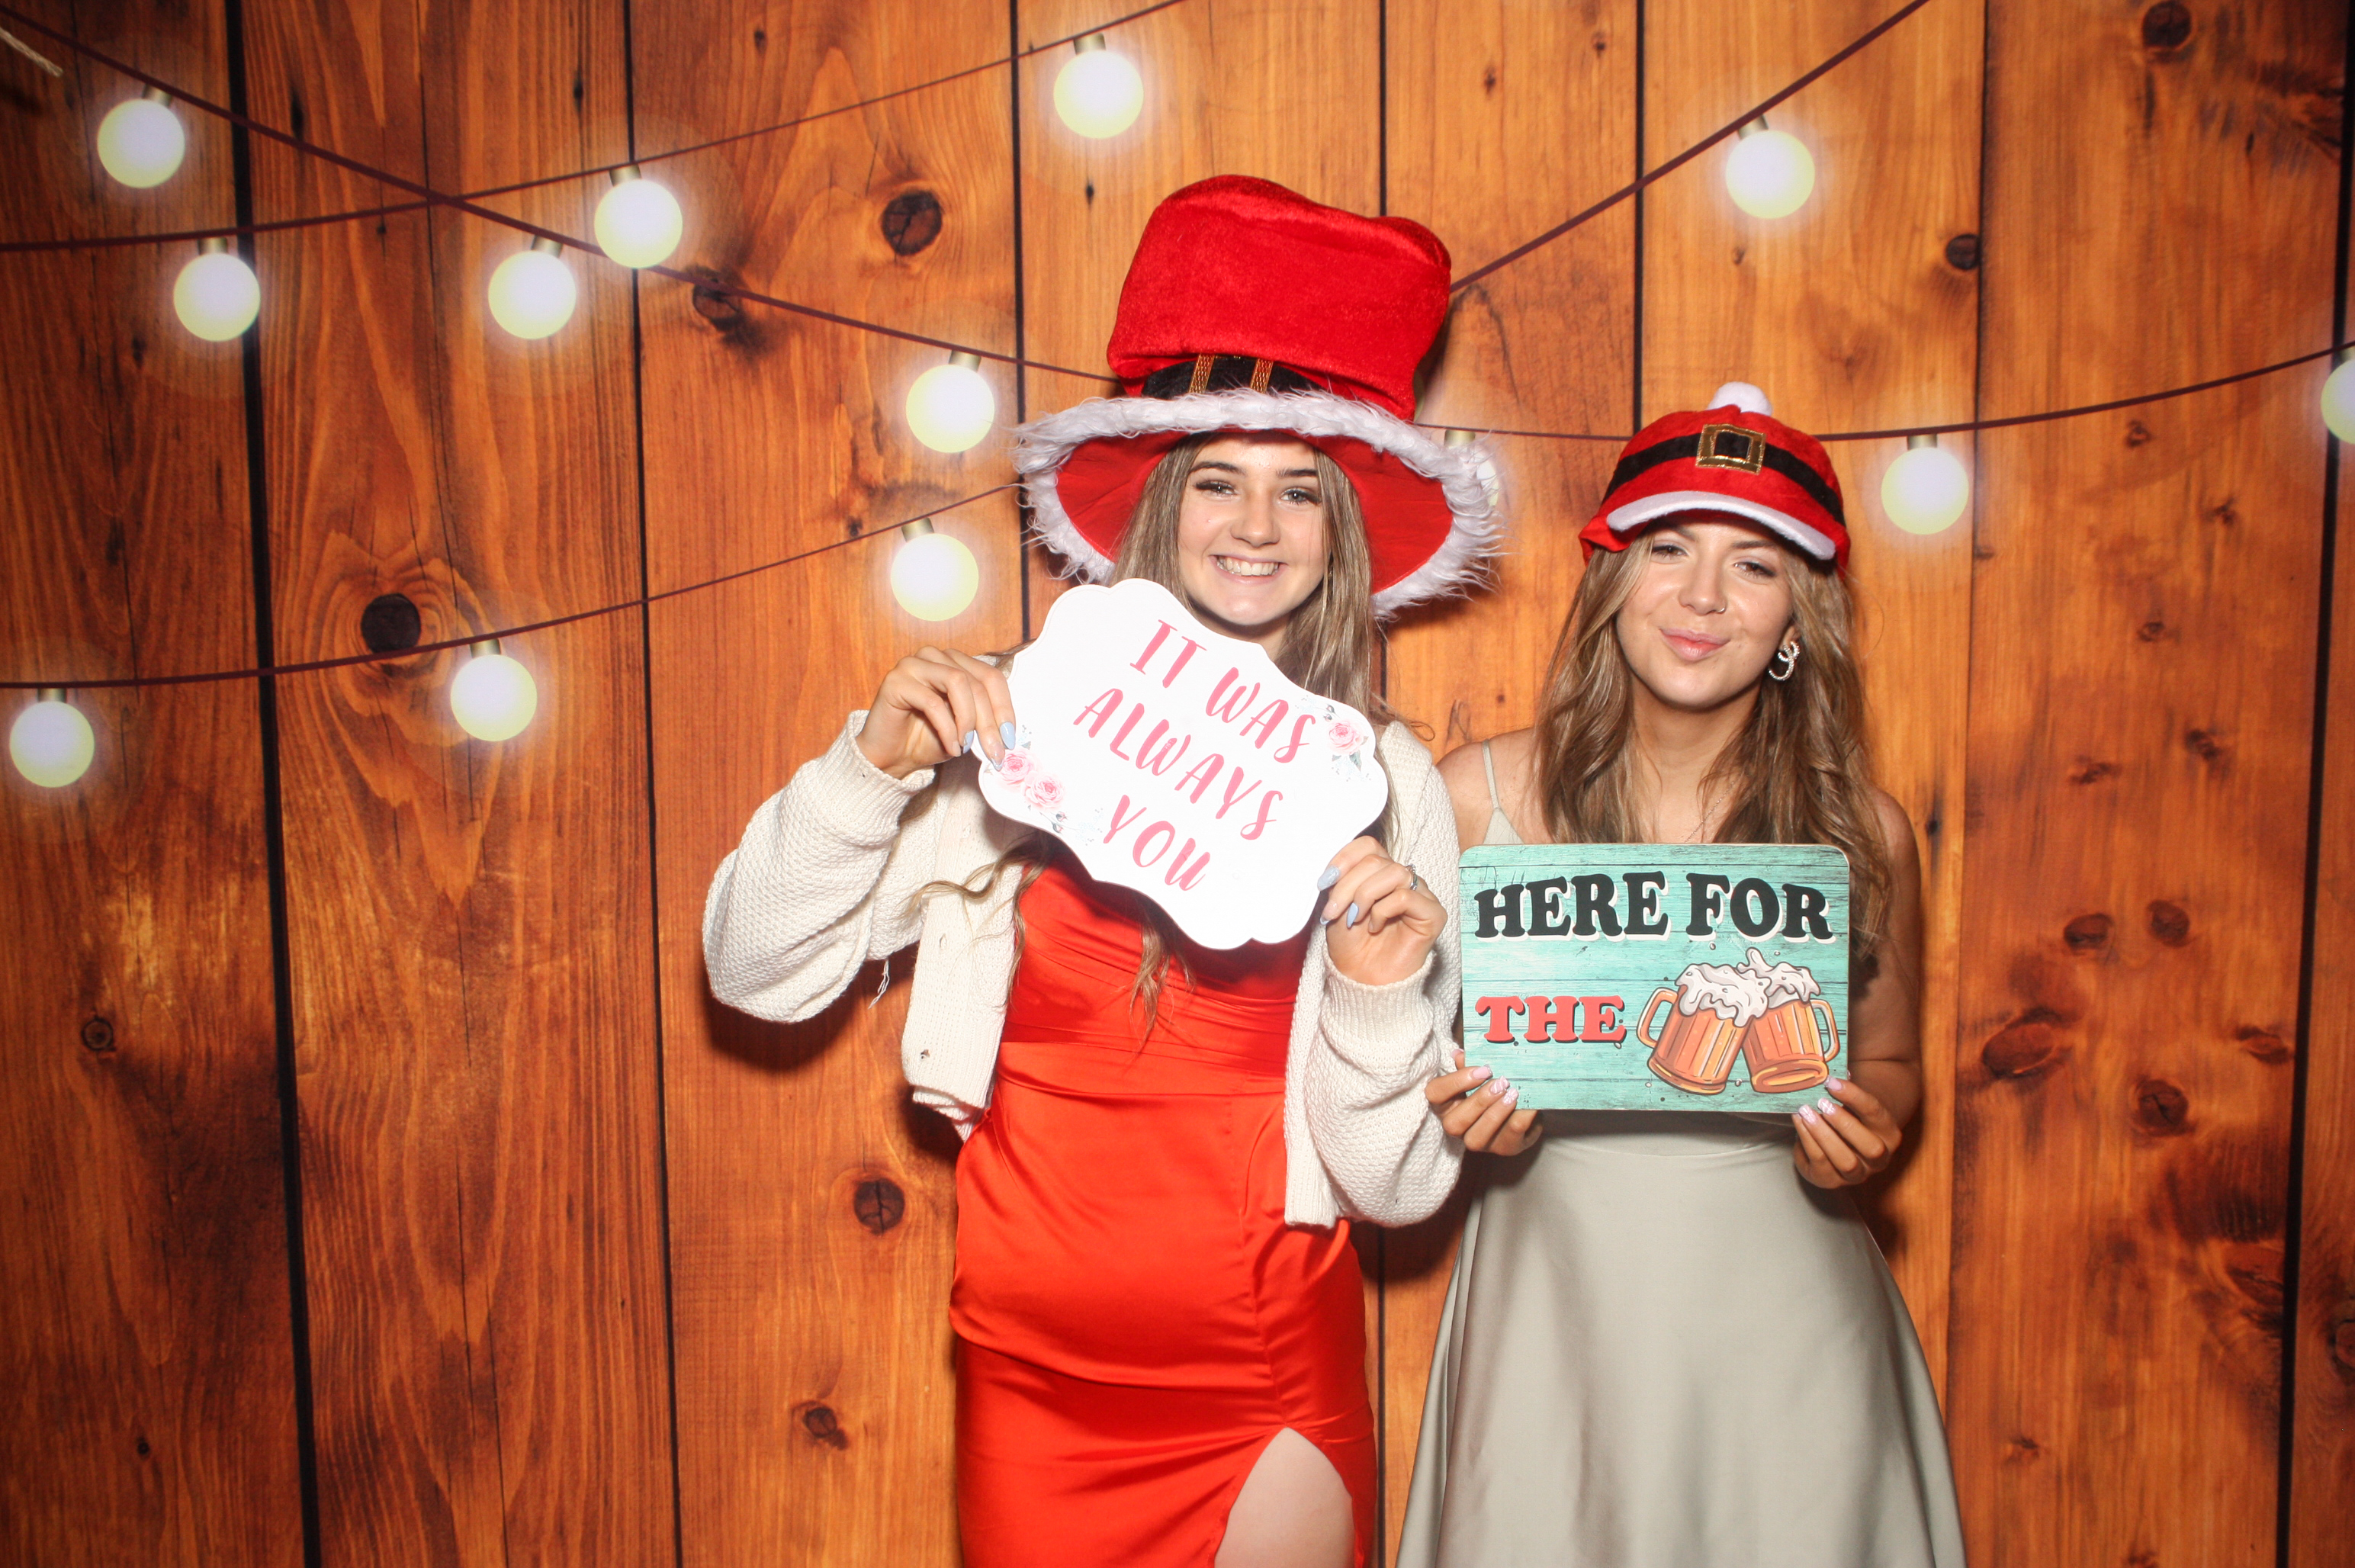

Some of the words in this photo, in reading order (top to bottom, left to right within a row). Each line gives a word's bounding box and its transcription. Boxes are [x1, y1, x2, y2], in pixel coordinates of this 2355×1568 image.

[1129, 619, 1207, 689] IT
[1205, 667, 1316, 763] WAS
[1072, 688, 1284, 840] ALWAYS
[1103, 794, 1211, 892] YOU
[1473, 871, 1671, 942] HERE
[1685, 872, 1836, 943] FOR
[1474, 994, 1627, 1044] THE
